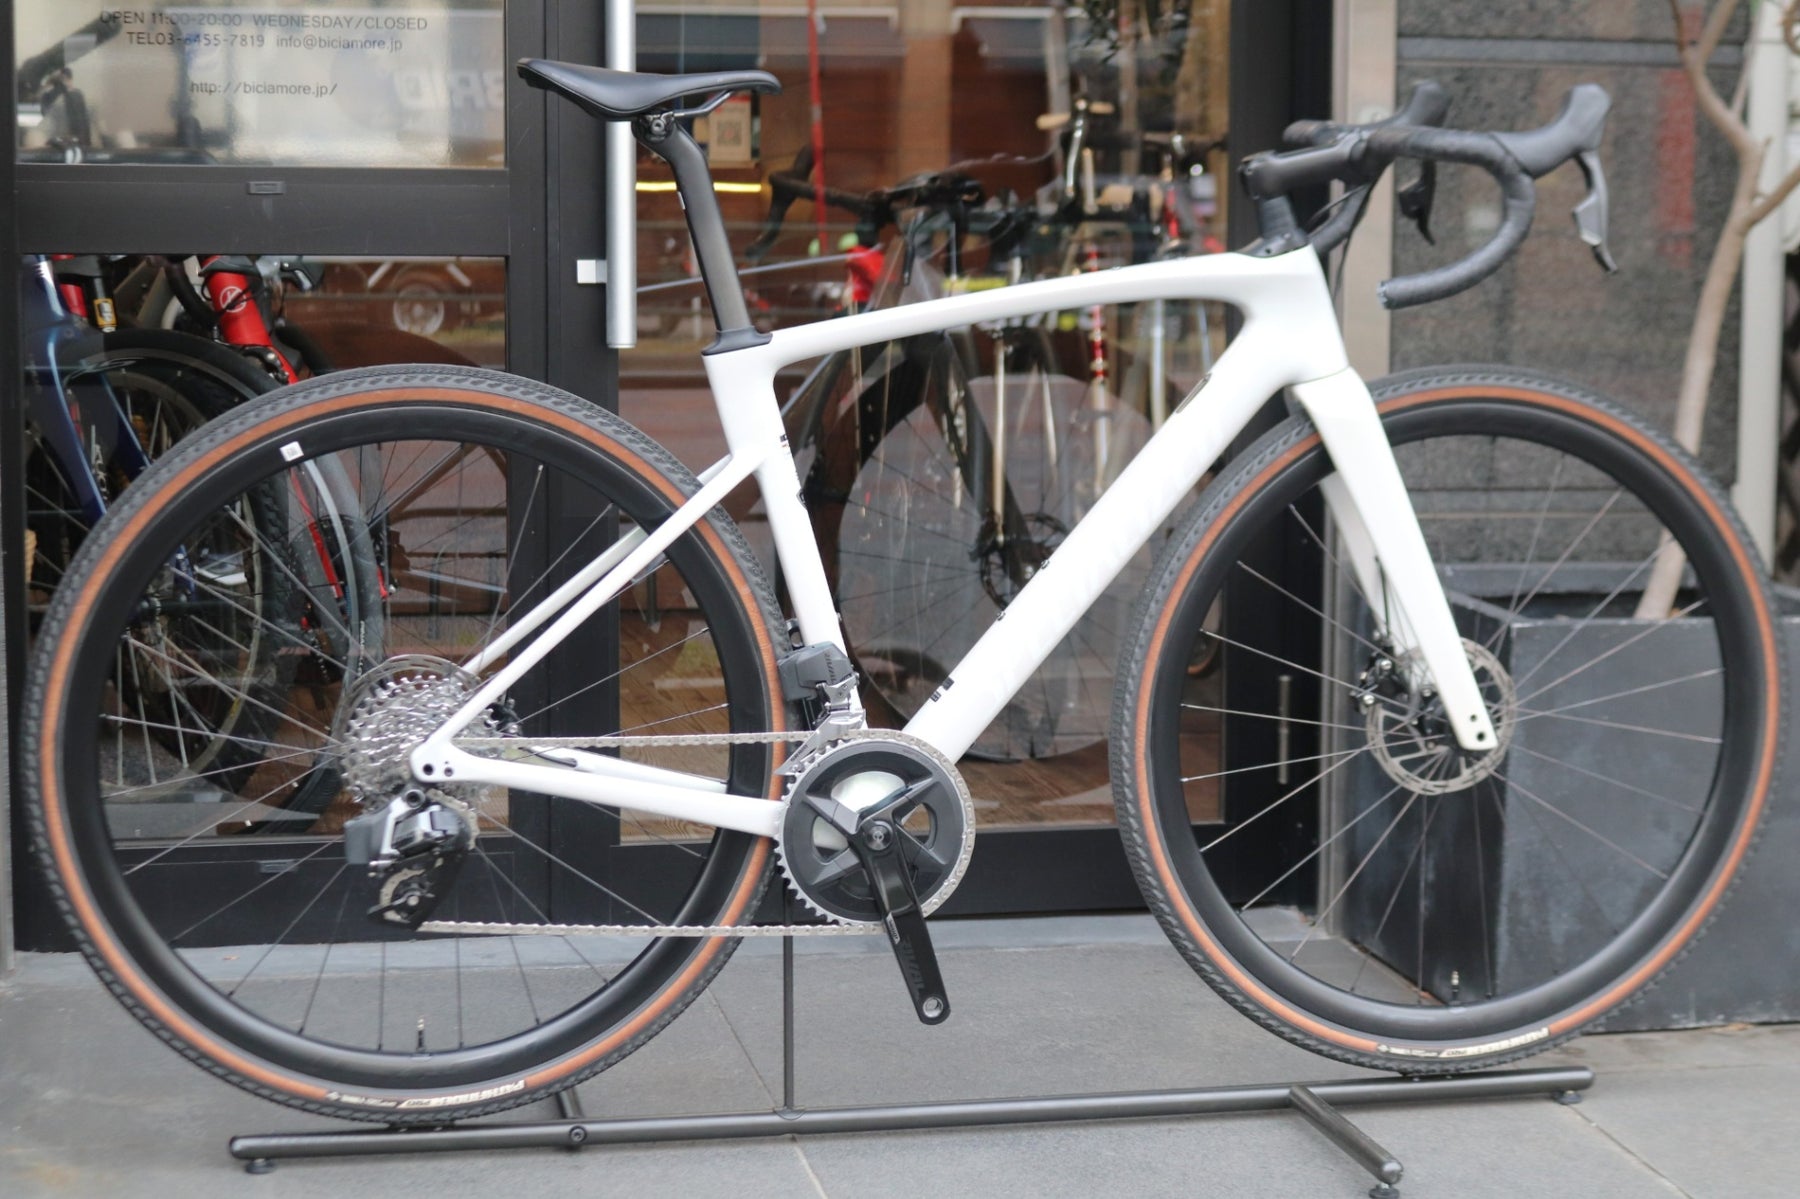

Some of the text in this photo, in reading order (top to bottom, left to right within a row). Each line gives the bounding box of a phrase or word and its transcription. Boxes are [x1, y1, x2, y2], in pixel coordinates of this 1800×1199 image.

[100, 10, 428, 31] OPEN 11:00-20:00 WEDNESDAY/CLOSED
[276, 34, 403, 53] info@biciamore.jp
[190, 81, 338, 98] http://biciamore.jp/
